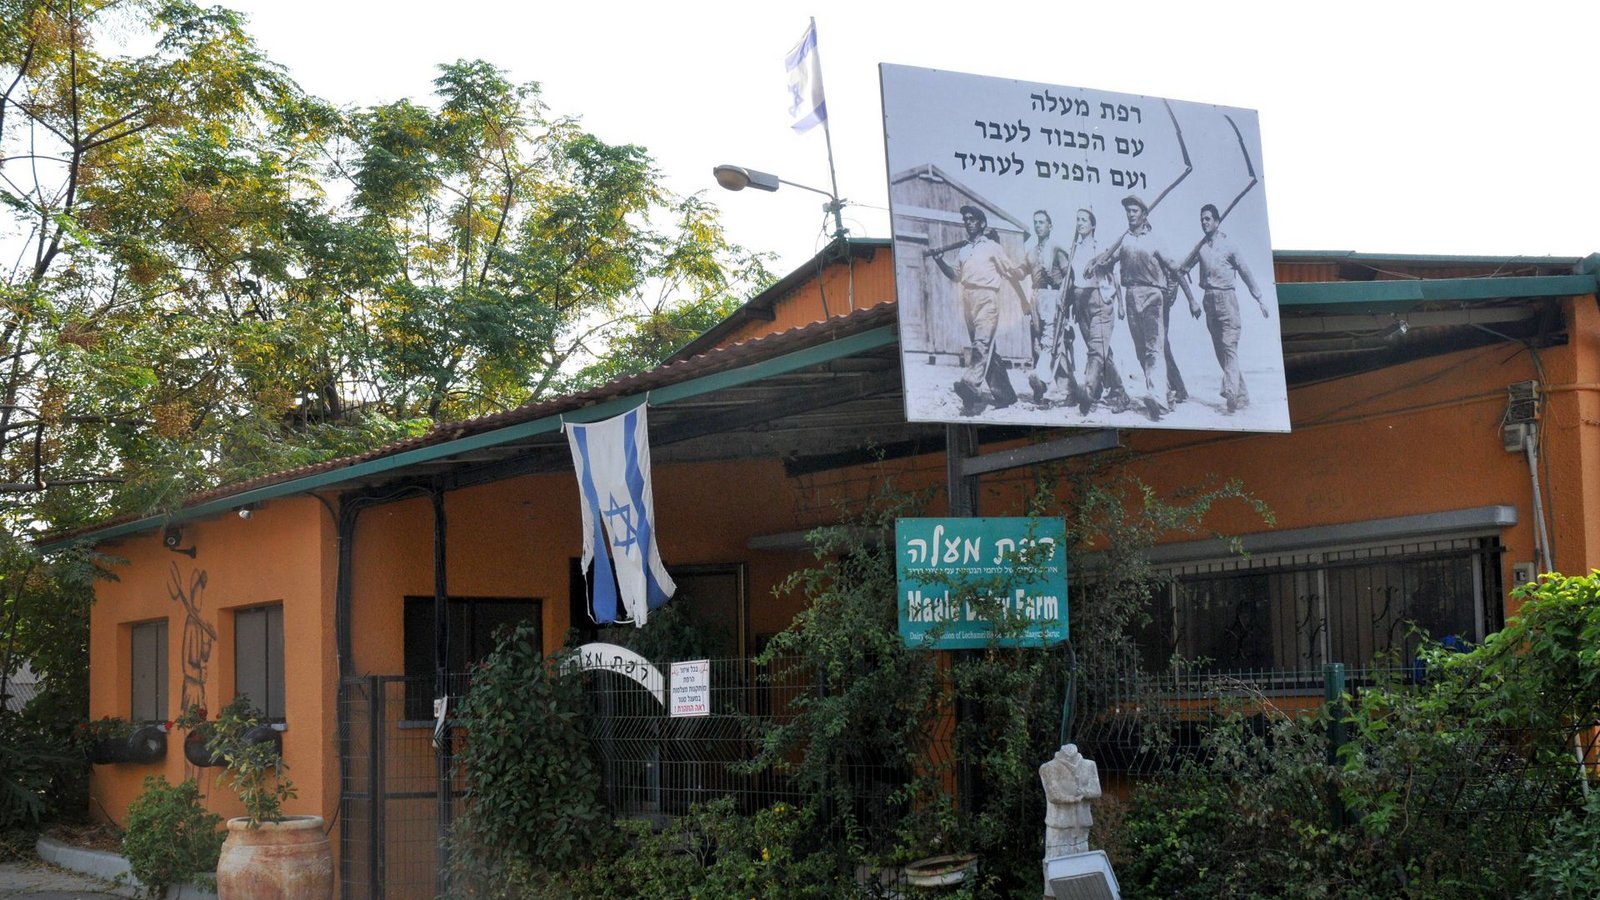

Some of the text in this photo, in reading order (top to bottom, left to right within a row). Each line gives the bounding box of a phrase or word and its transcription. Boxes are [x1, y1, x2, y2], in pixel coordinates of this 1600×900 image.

[1030, 89, 1141, 124] רפת מעלה
[974, 119, 1144, 157] עם הכבוד לעבר
[954, 151, 1147, 190] ועם הפנים לעתיד
[907, 524, 981, 567] מעלה
[1015, 589, 1058, 620] Farm
[611, 656, 648, 680] רפת
